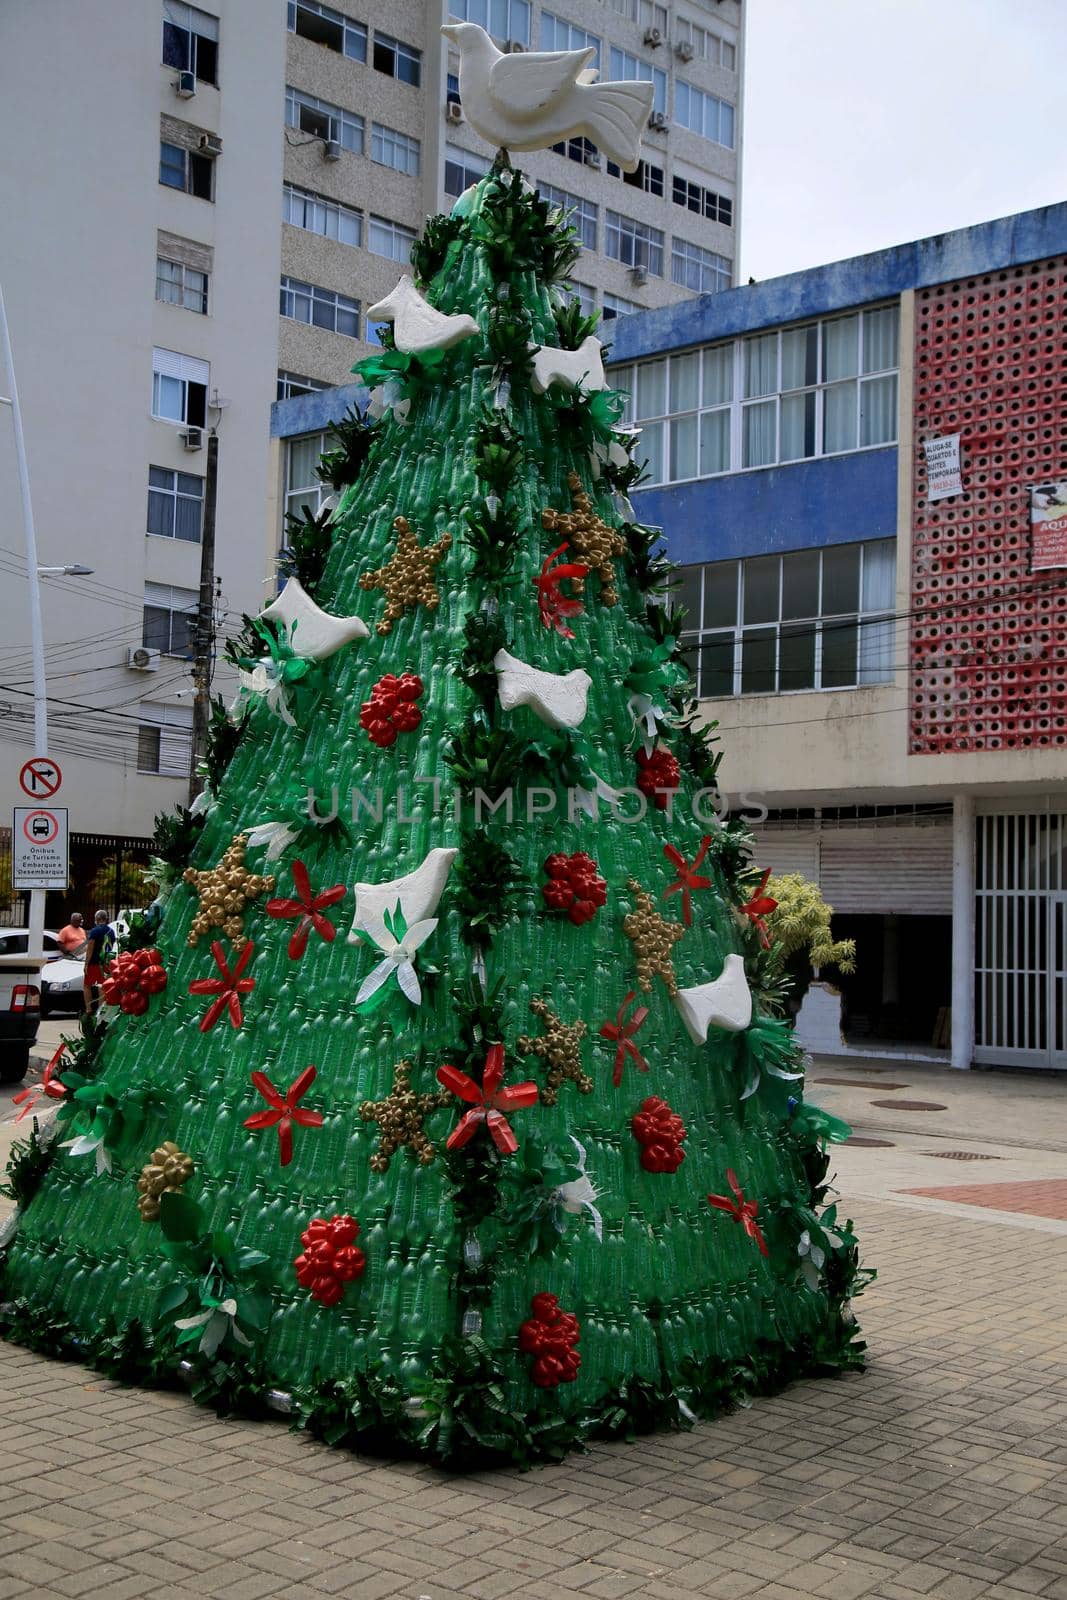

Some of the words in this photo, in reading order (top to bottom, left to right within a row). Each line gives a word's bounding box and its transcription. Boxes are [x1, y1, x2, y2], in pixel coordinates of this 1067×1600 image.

[926, 441, 952, 453] ALUGA-SE
[928, 450, 952, 462] QUARTOS
[928, 467, 960, 480] TEMPORADA
